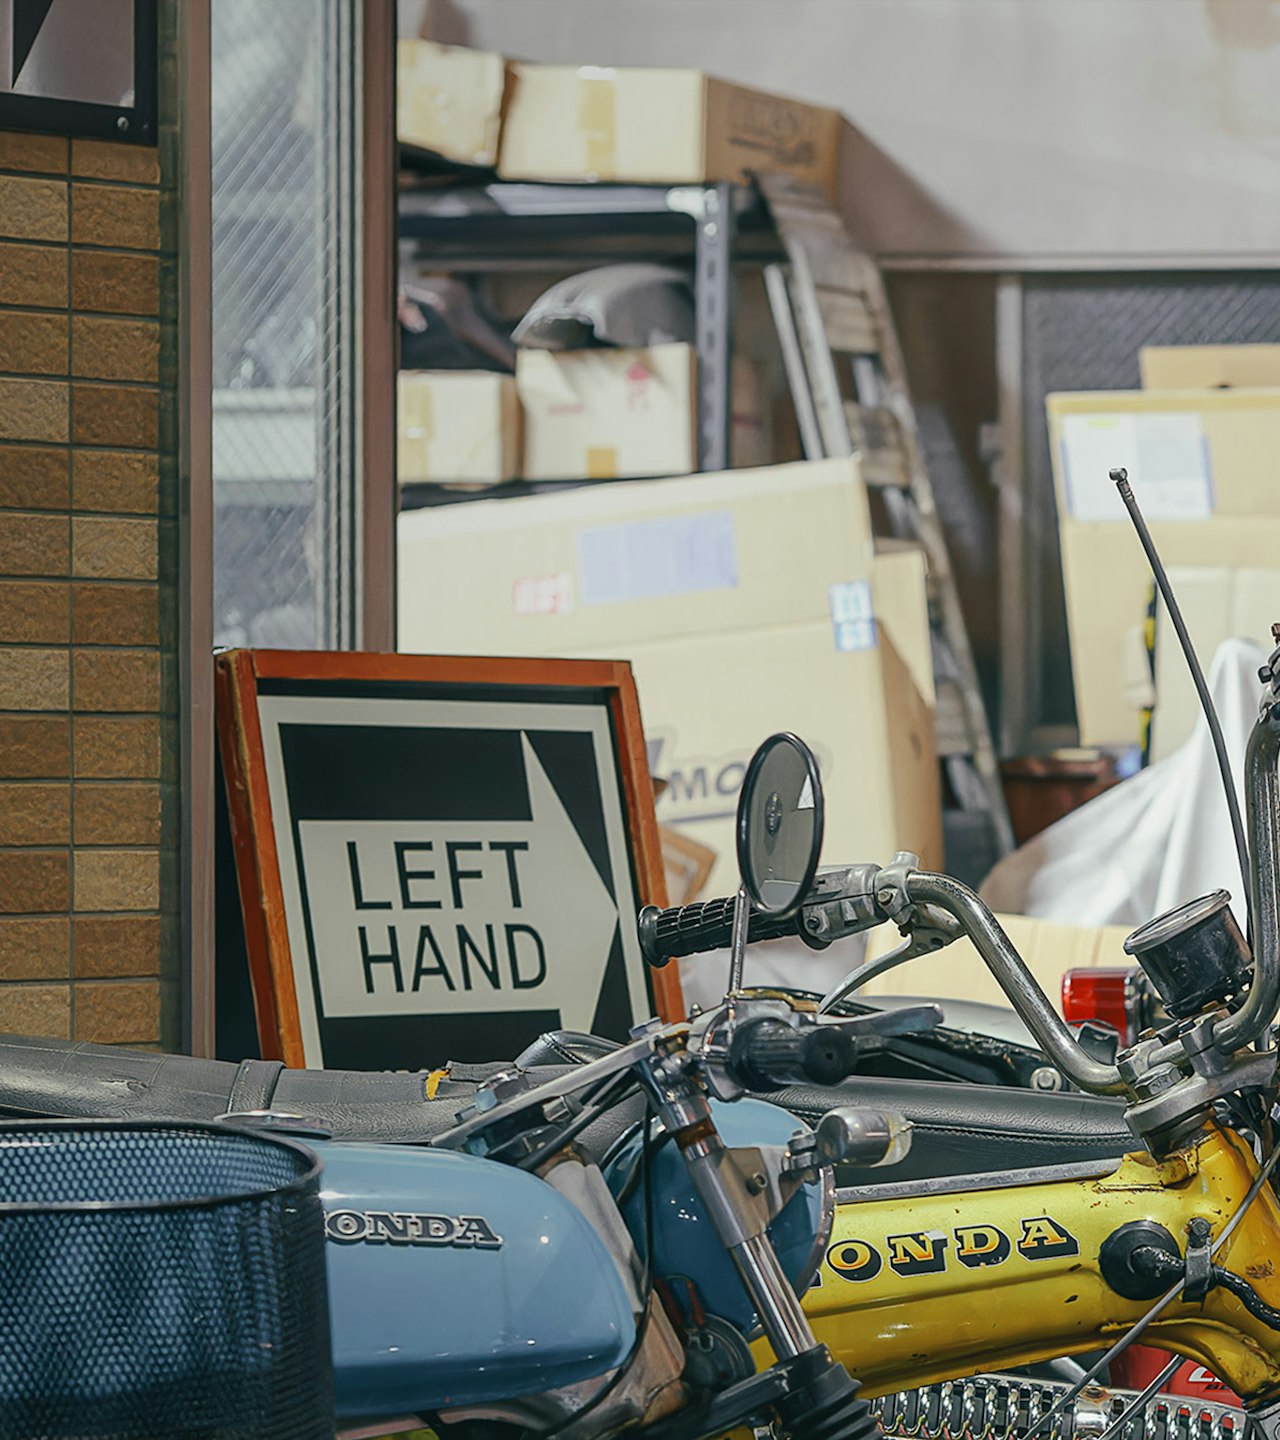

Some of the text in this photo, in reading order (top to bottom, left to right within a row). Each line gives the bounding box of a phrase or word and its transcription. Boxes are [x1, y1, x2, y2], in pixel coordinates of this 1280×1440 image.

[346, 841, 529, 911] LEFT
[357, 924, 547, 994] HAND
[322, 1208, 504, 1250] ONDA
[808, 1215, 1080, 1289] ONDA
